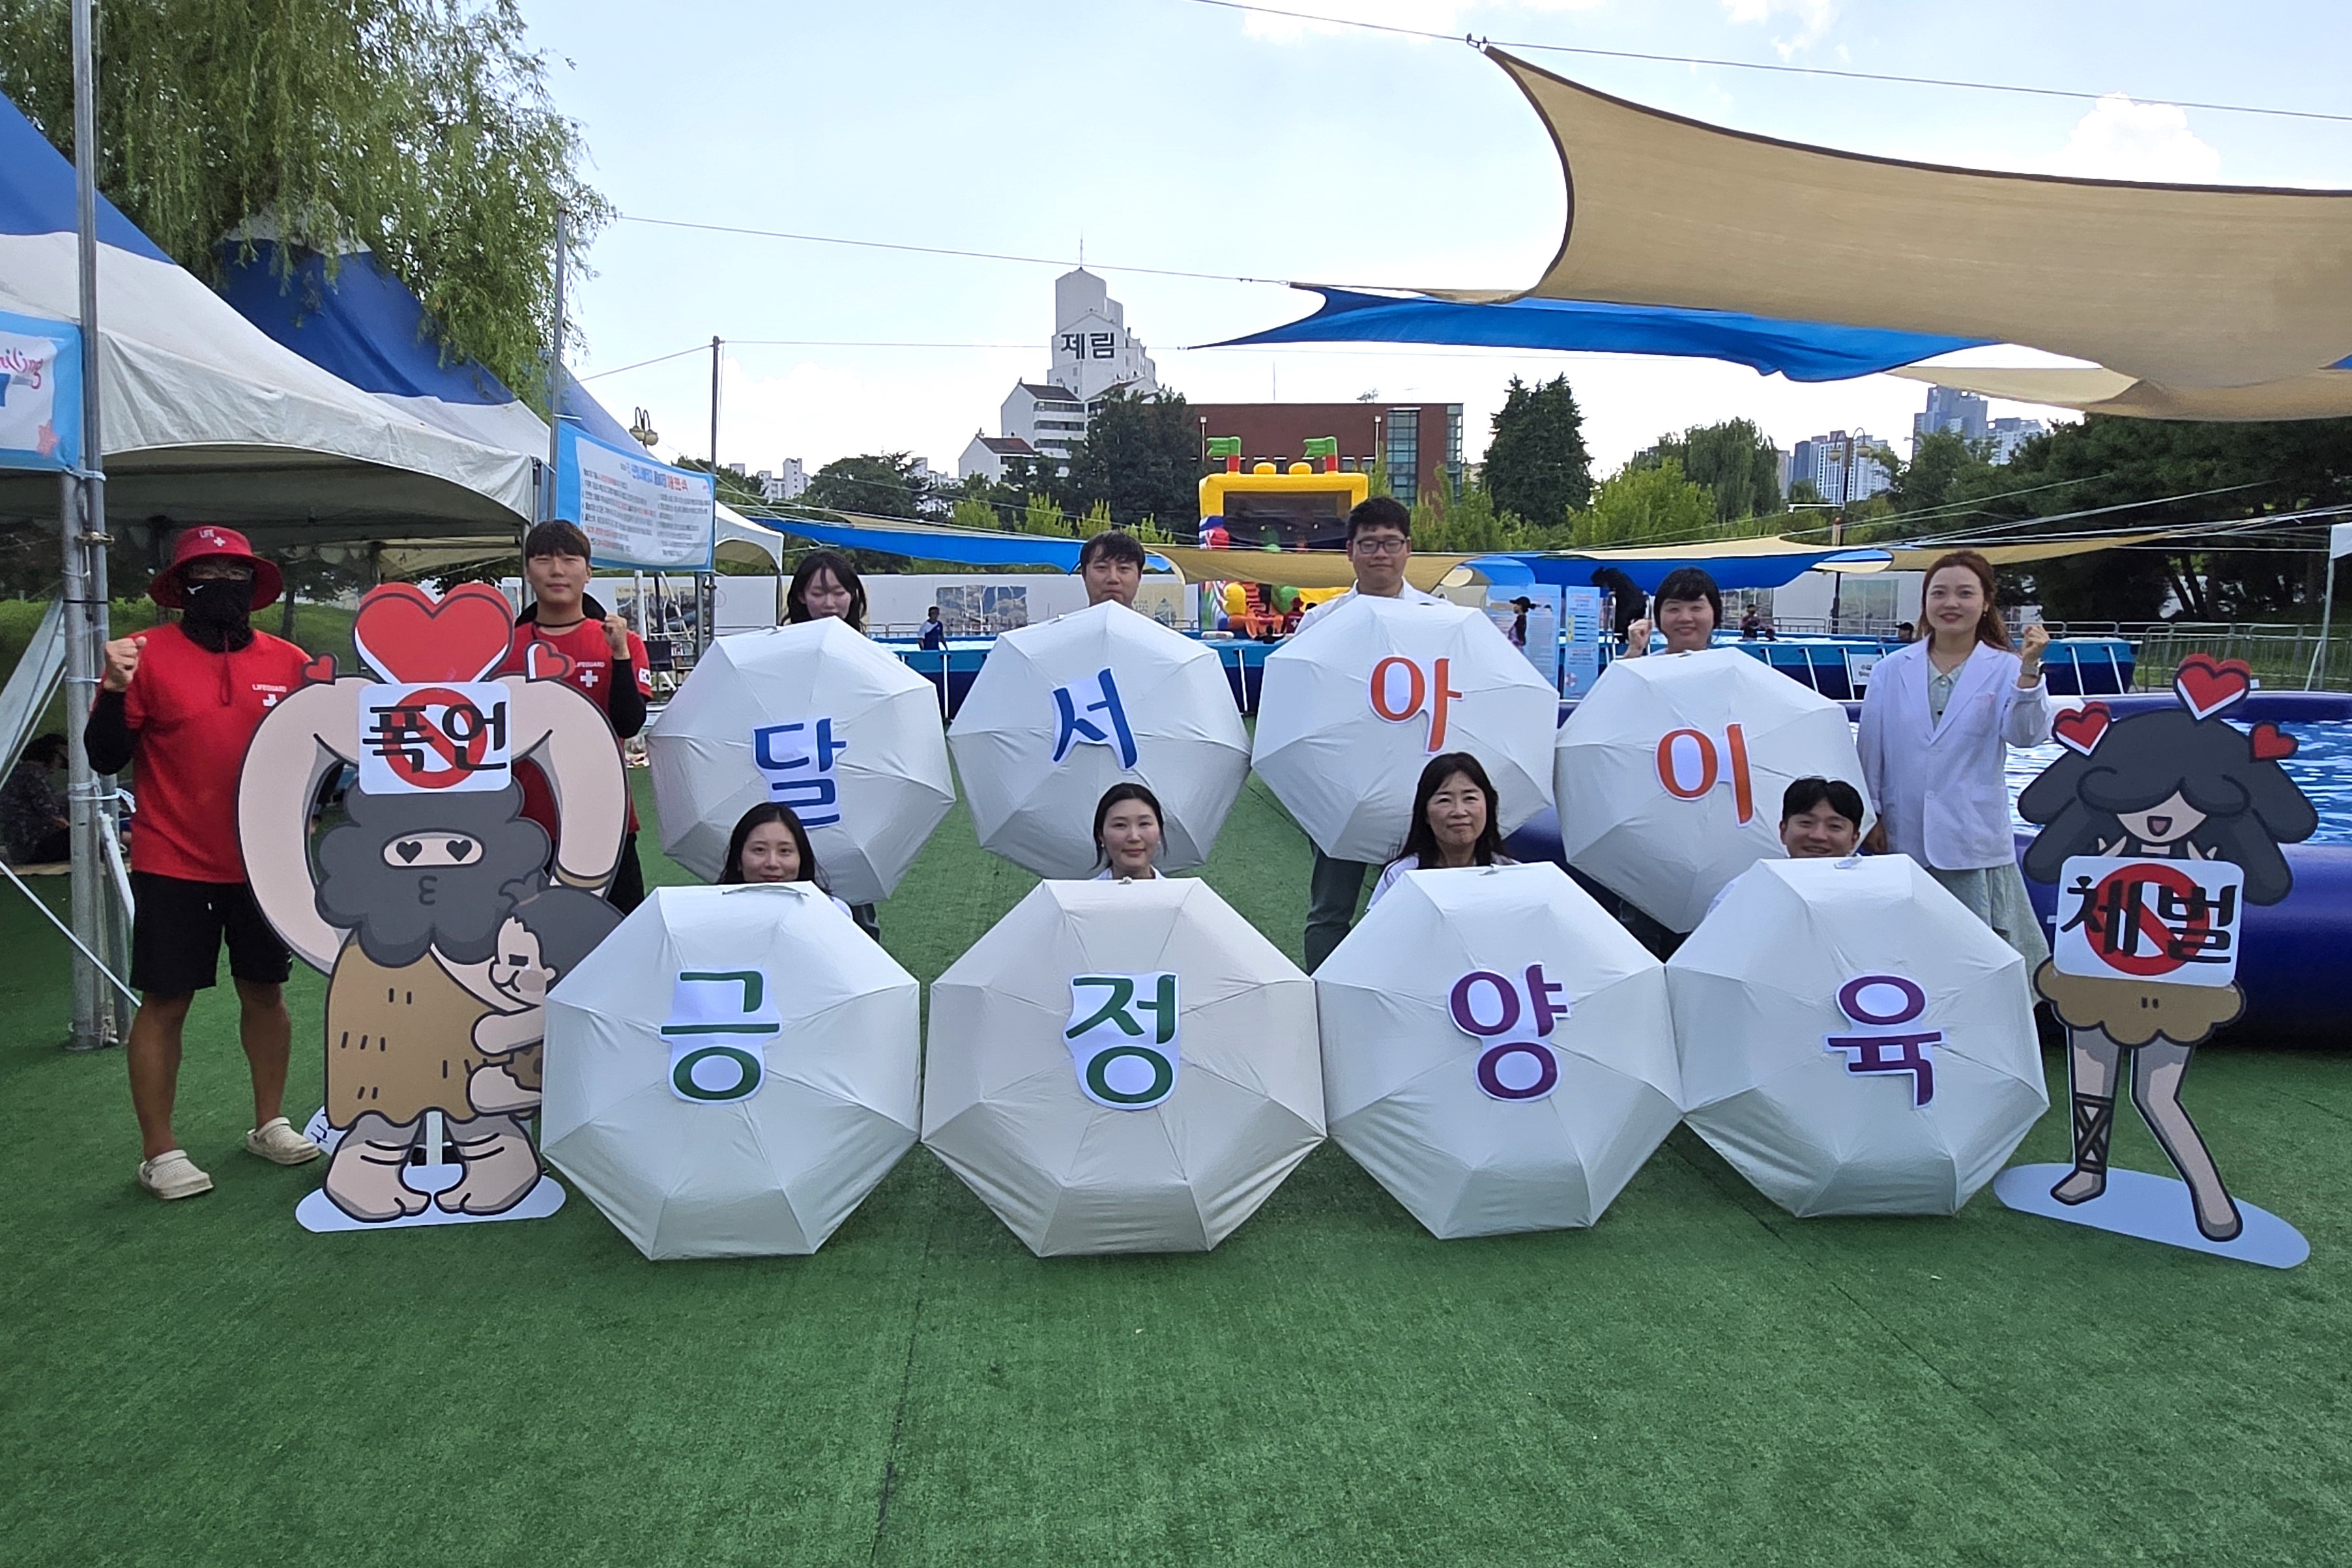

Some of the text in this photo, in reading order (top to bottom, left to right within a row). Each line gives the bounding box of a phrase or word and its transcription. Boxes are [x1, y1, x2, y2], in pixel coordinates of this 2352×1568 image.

[1060, 332, 1114, 360] 제림
[362, 701, 507, 773] 폭언
[755, 657, 1754, 826] 달 서 아 이
[2060, 876, 2237, 963] 체벌
[661, 965, 1942, 1106] 긍 정 양 육
